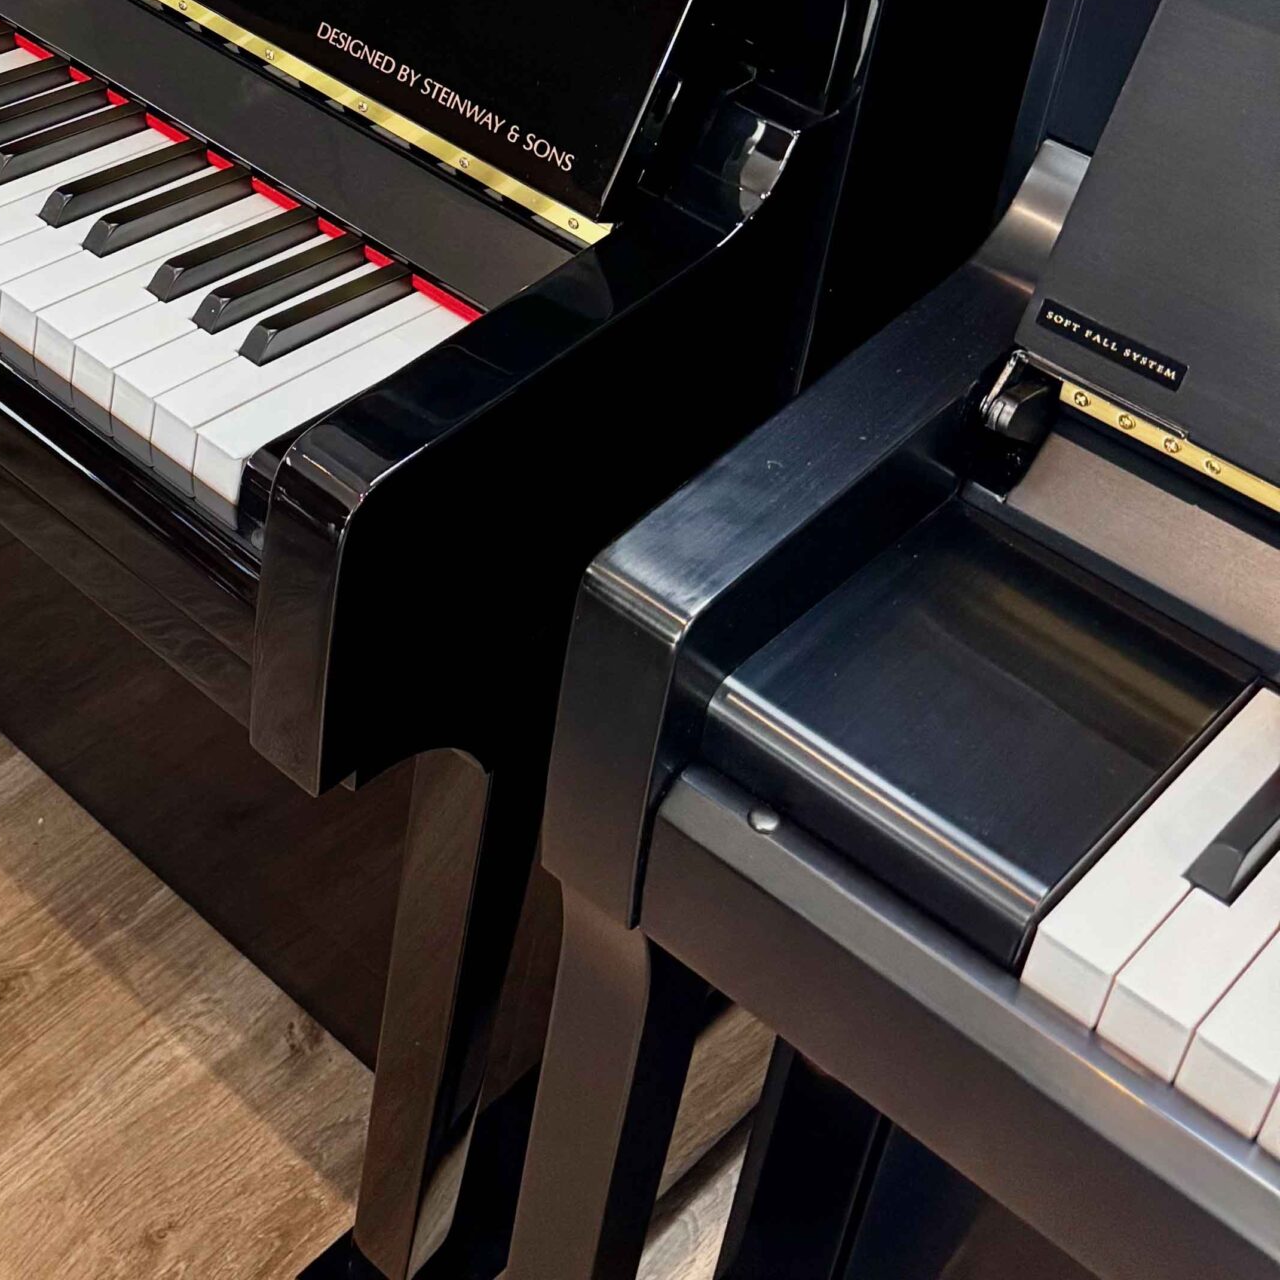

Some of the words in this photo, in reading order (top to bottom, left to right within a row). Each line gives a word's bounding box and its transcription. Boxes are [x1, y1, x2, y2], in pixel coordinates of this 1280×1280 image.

[317, 21, 396, 75] DESIGNED
[397, 65, 421, 87] BY
[420, 78, 506, 134] STEINWAY
[507, 125, 520, 143] &
[523, 133, 575, 172] SONS
[1046, 310, 1081, 333] SOFT
[1084, 329, 1118, 352] FALL
[1123, 348, 1177, 381] SYSTEM
